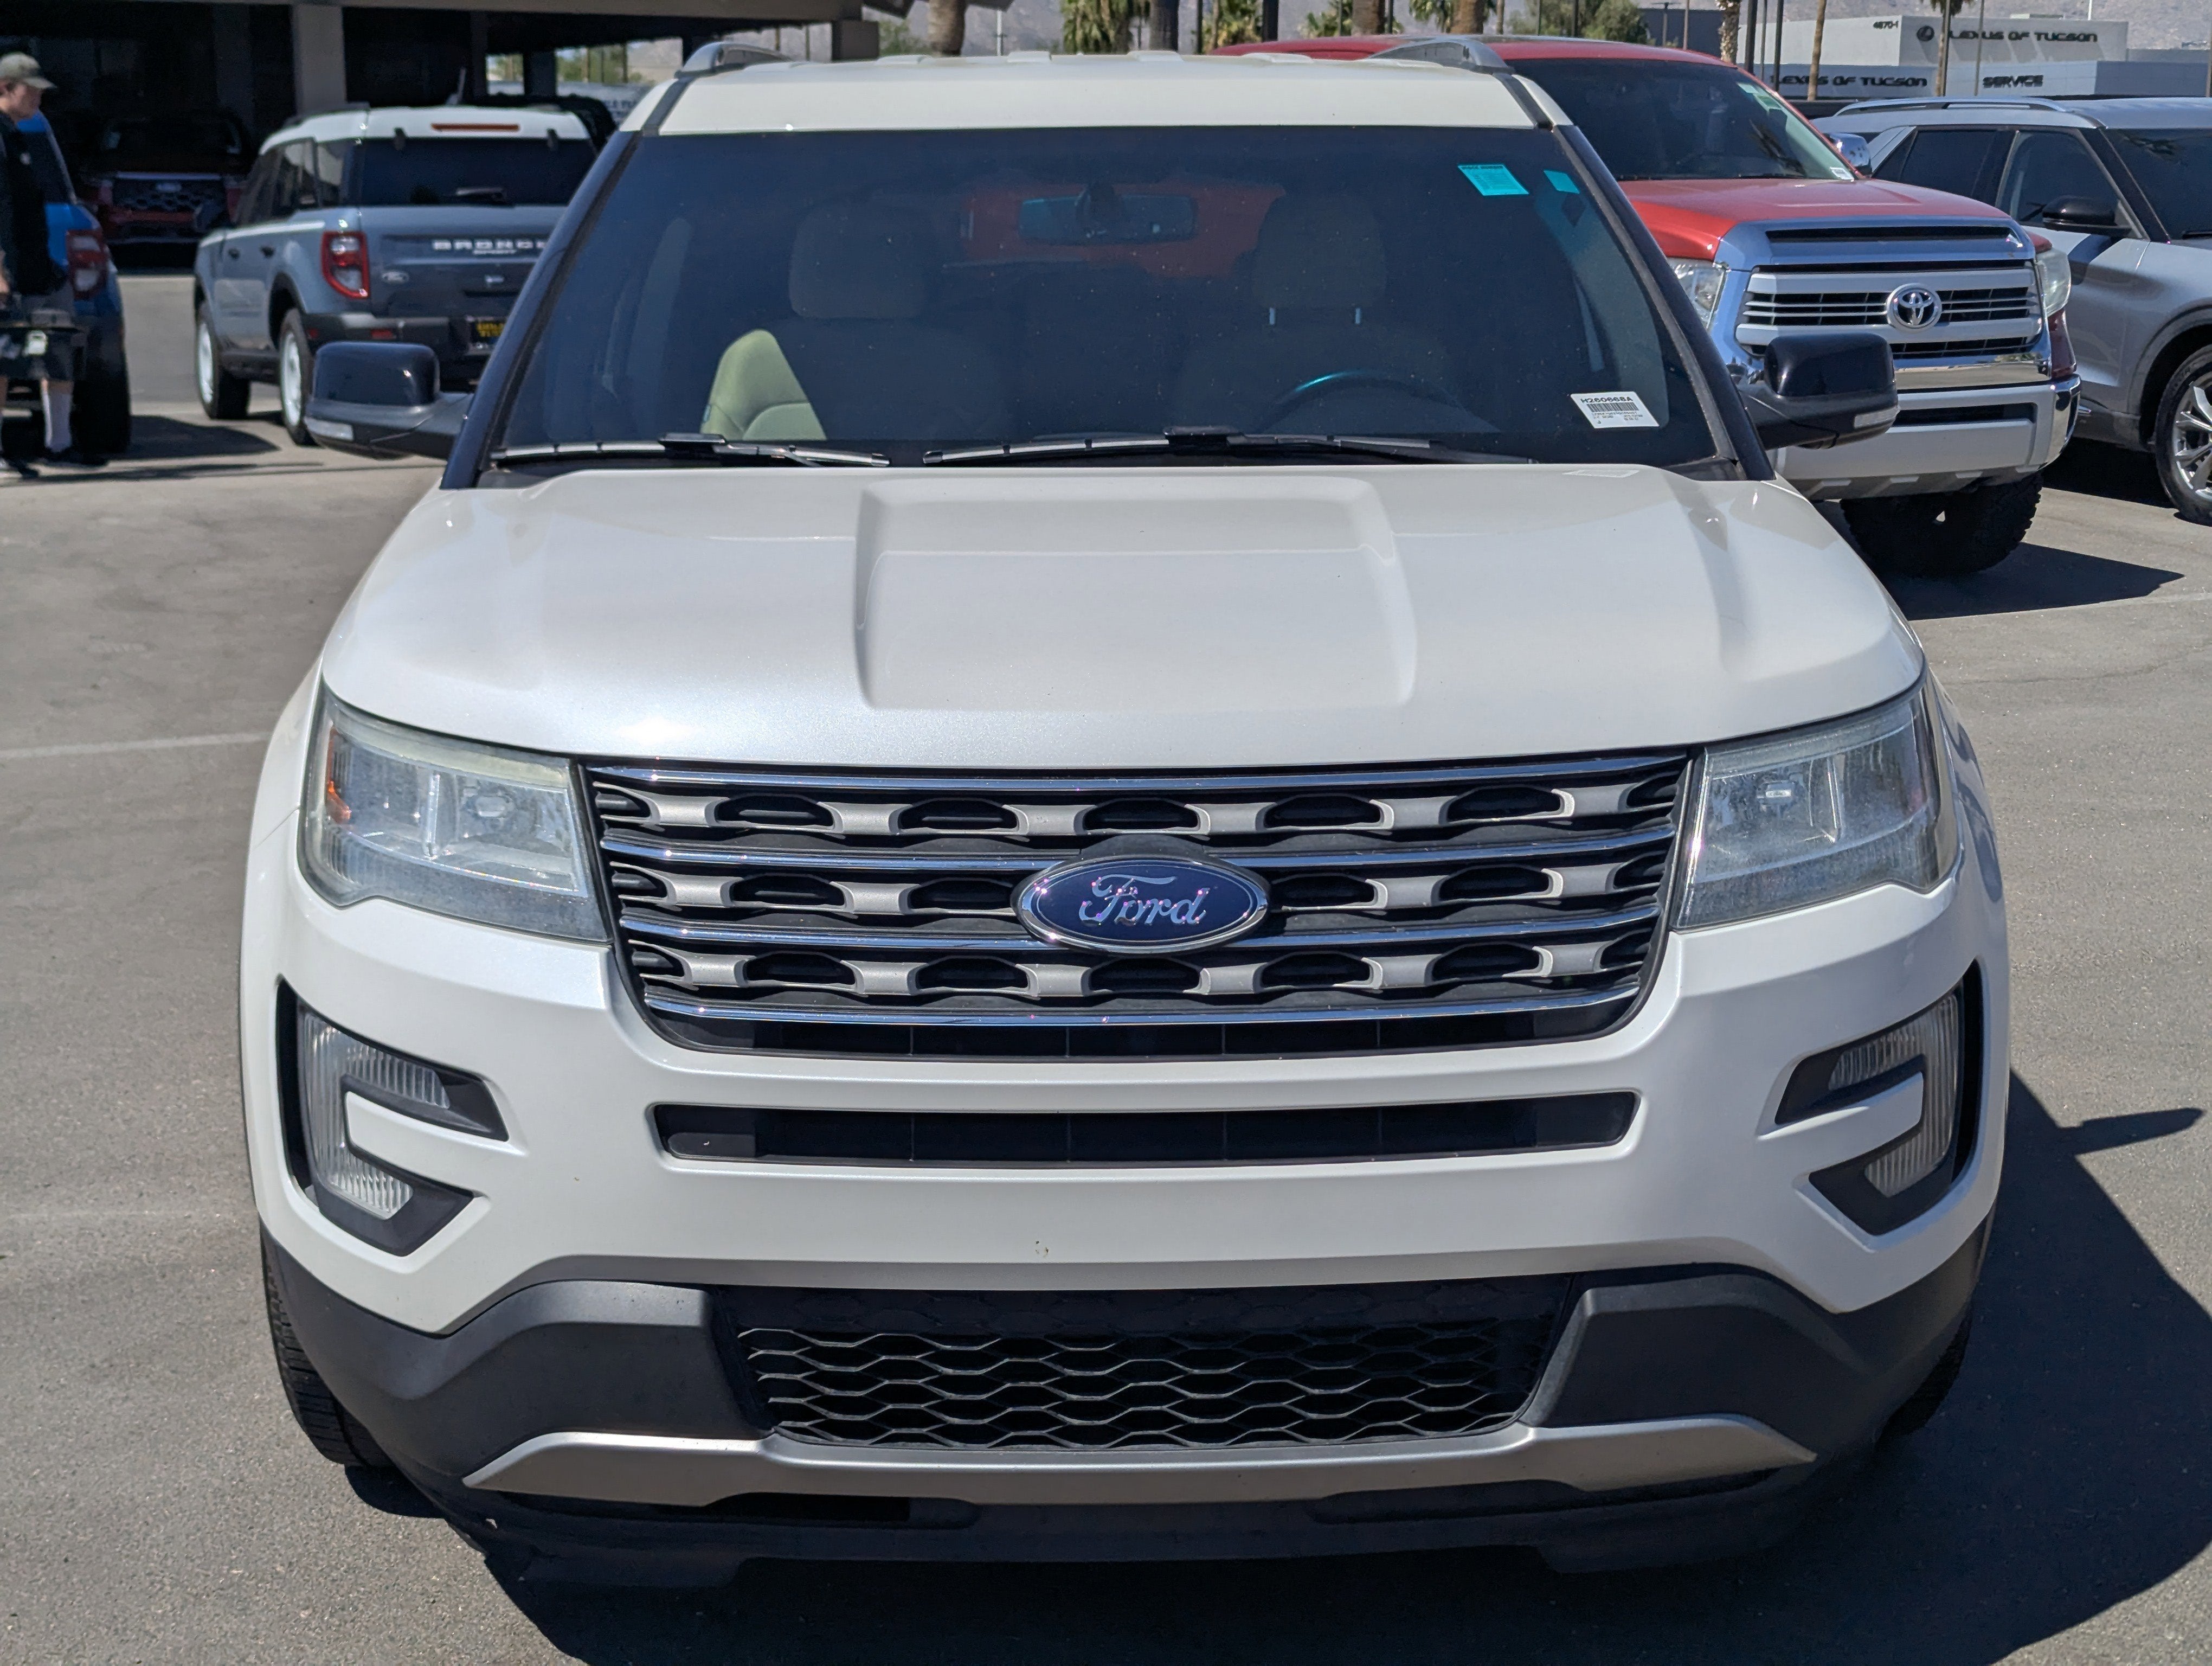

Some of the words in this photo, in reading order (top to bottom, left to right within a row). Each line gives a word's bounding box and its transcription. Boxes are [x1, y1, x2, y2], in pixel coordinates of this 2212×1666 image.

[2008, 31, 2030, 41] OF
[2034, 32, 2098, 42] TUCSON
[1833, 76, 1856, 86] OF
[1860, 77, 1927, 87] TUCSON
[1983, 75, 2043, 88] SERVICE
[1078, 874, 1210, 926] Ford
